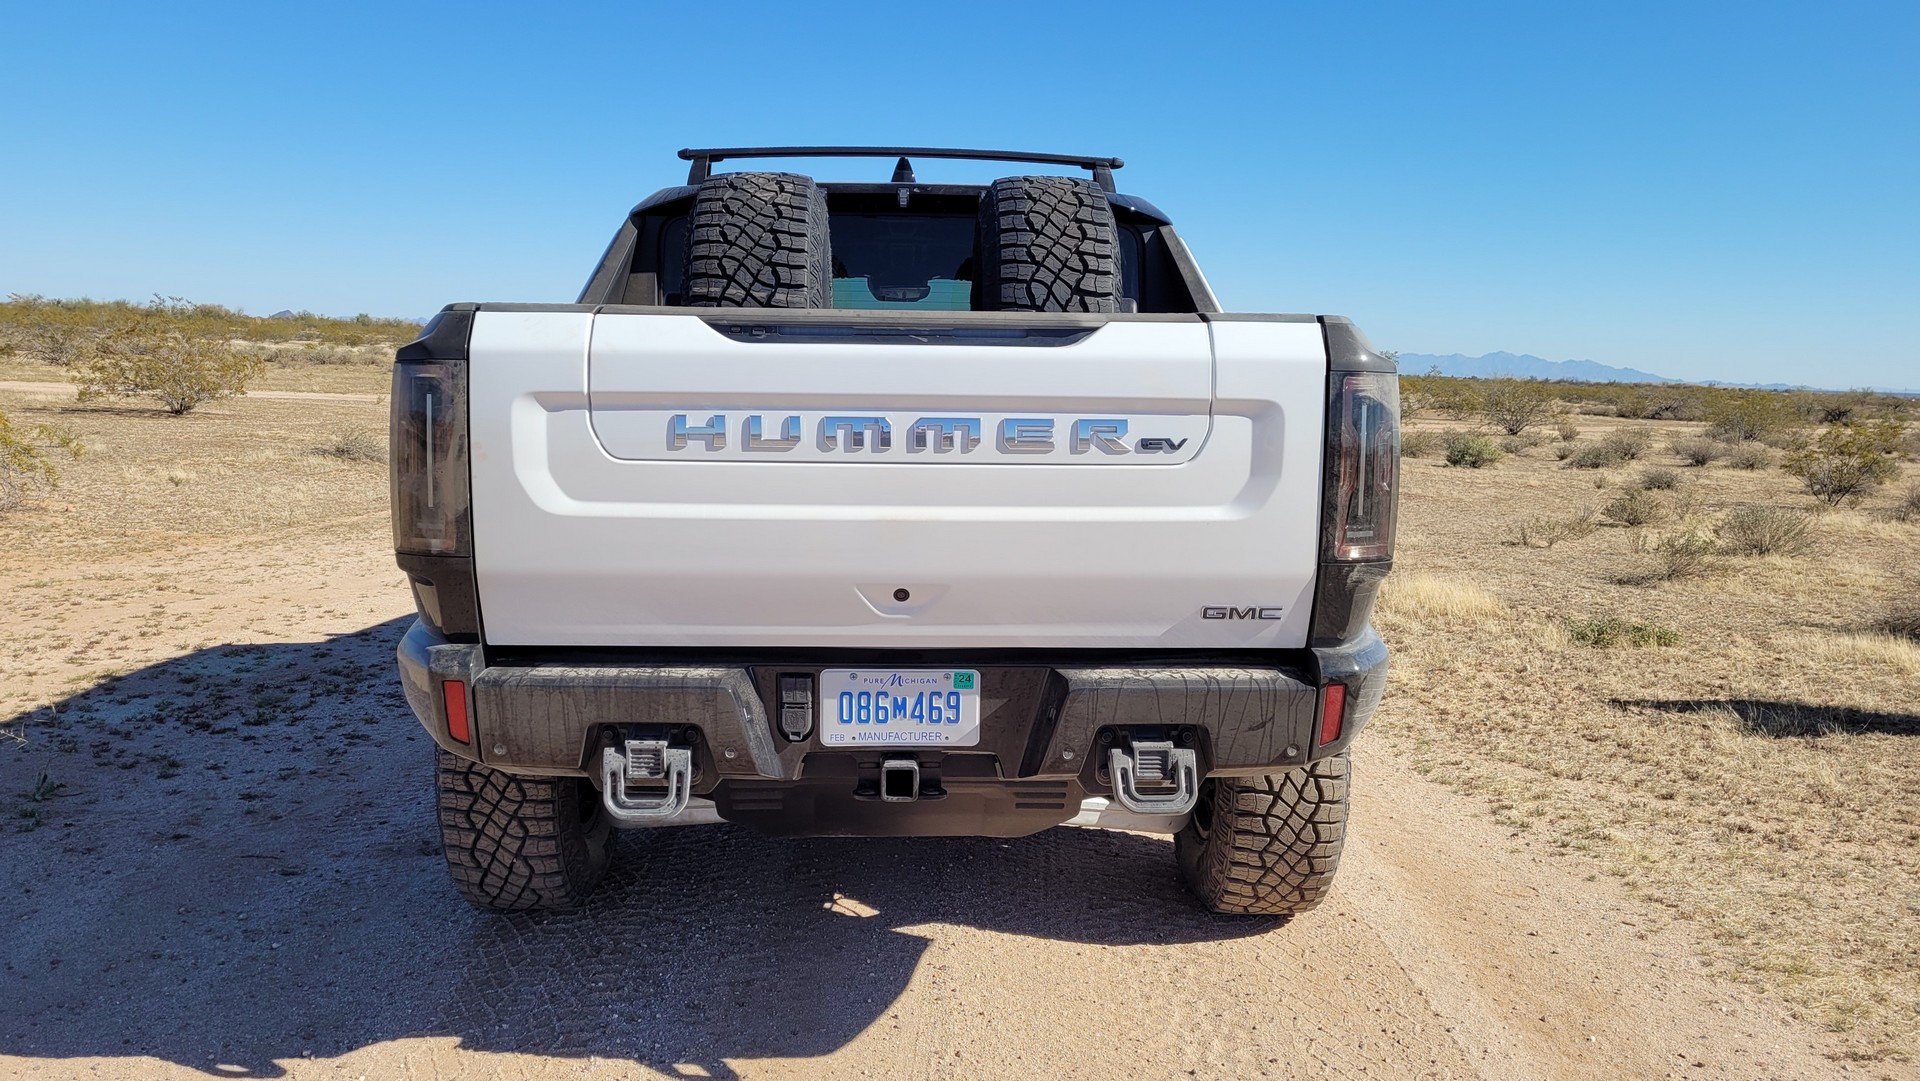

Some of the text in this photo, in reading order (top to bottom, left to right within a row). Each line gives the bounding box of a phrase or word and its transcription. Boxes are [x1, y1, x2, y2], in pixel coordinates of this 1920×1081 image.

[670, 414, 1188, 453] HUMMER EV
[1201, 606, 1283, 620] GMC
[863, 677, 884, 685] PURE
[958, 674, 972, 684] 24
[838, 691, 961, 724] 086M469
[829, 732, 942, 742] FEB MANUFACTURER
